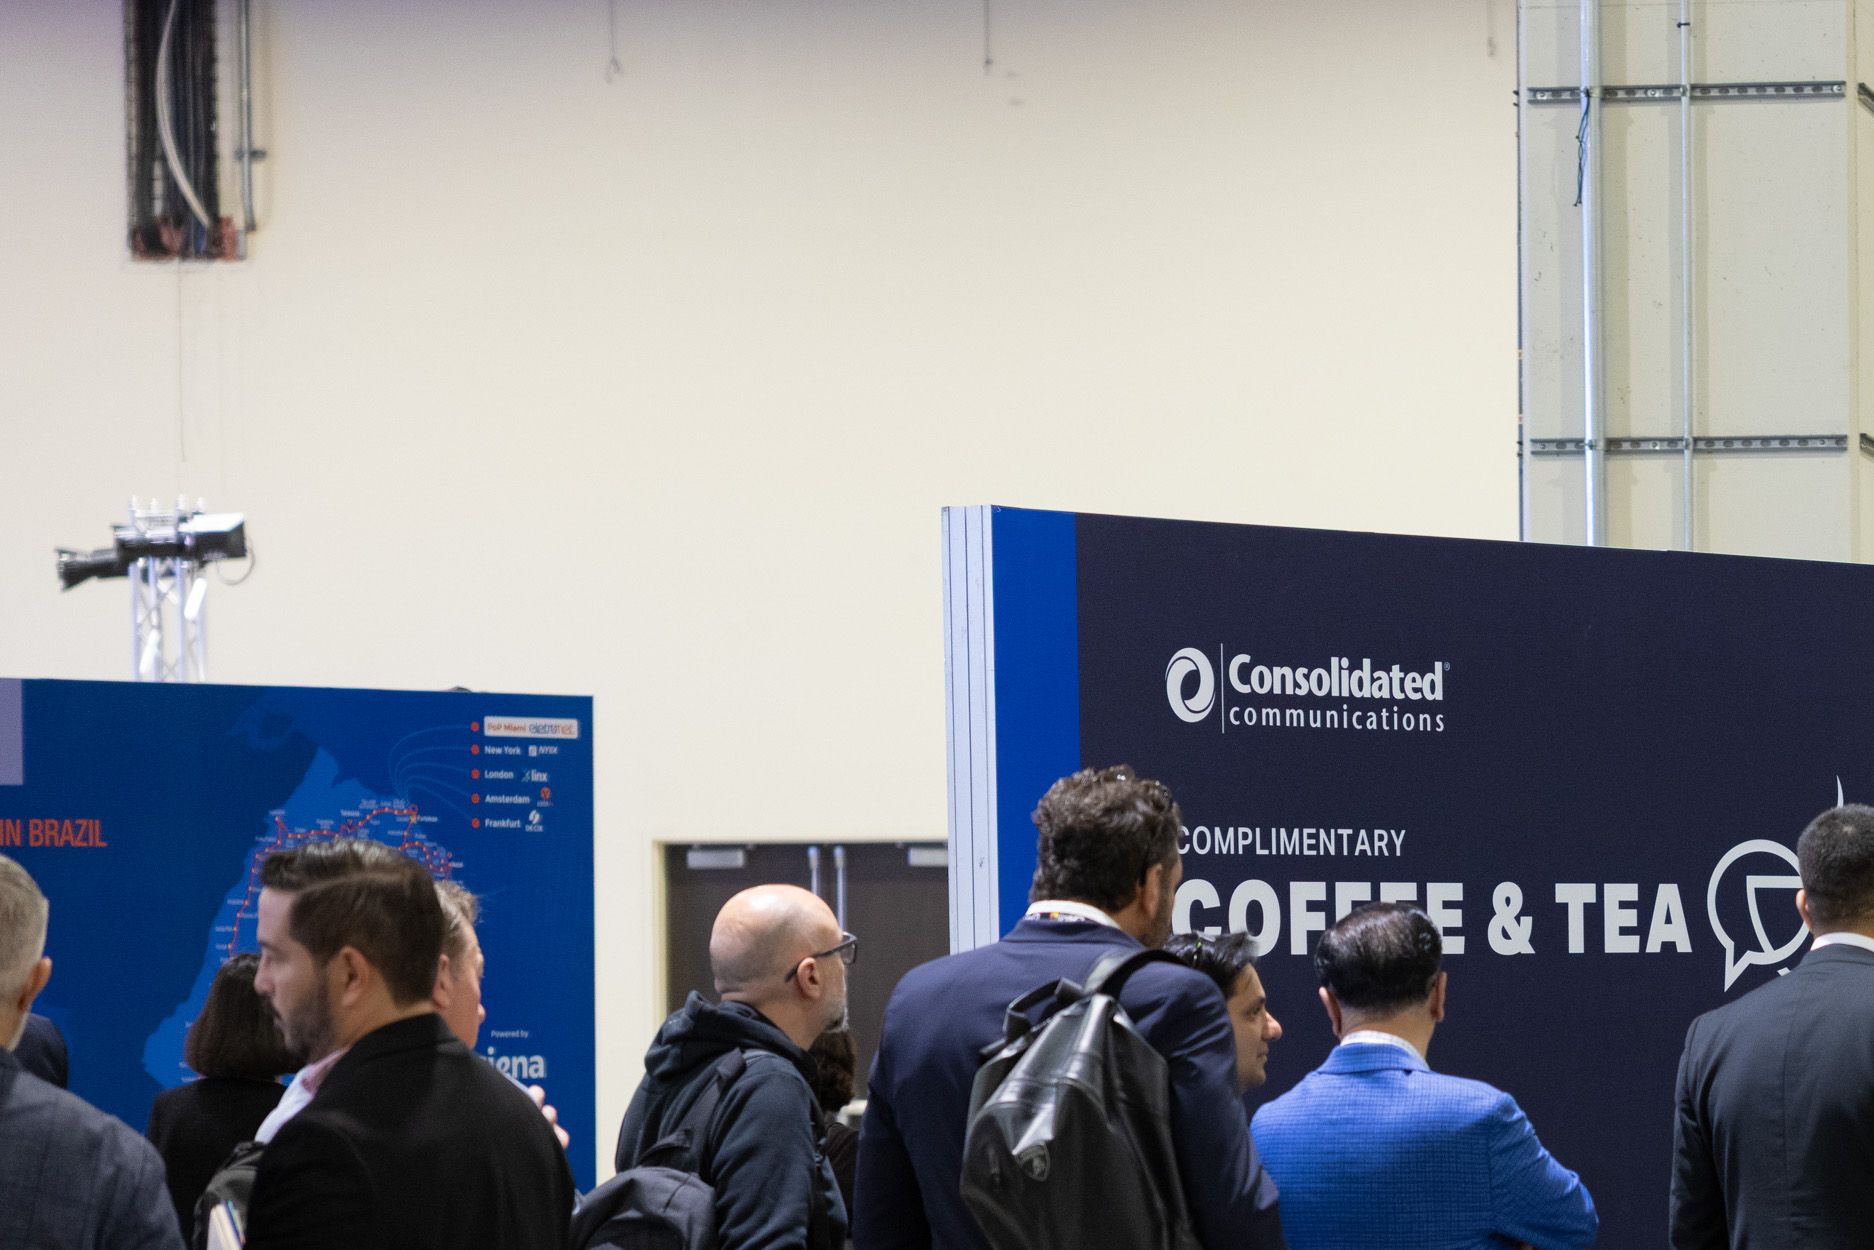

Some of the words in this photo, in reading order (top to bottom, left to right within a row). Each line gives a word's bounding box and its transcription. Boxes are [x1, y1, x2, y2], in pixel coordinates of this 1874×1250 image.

[1229, 703, 1445, 732] communications
[485, 745, 502, 755] New
[503, 745, 521, 755] York
[485, 769, 514, 779] London
[485, 794, 530, 804] Amsterdam
[485, 817, 521, 828] Frankfurt
[28, 818, 109, 848] BRAZIL
[1177, 825, 1406, 857] COMPLIMENTARY
[1486, 880, 1536, 956] &
[1554, 882, 1693, 954] TEA
[490, 1030, 519, 1039] Powered
[520, 1030, 529, 1039] by
[479, 1046, 545, 1079] iena
